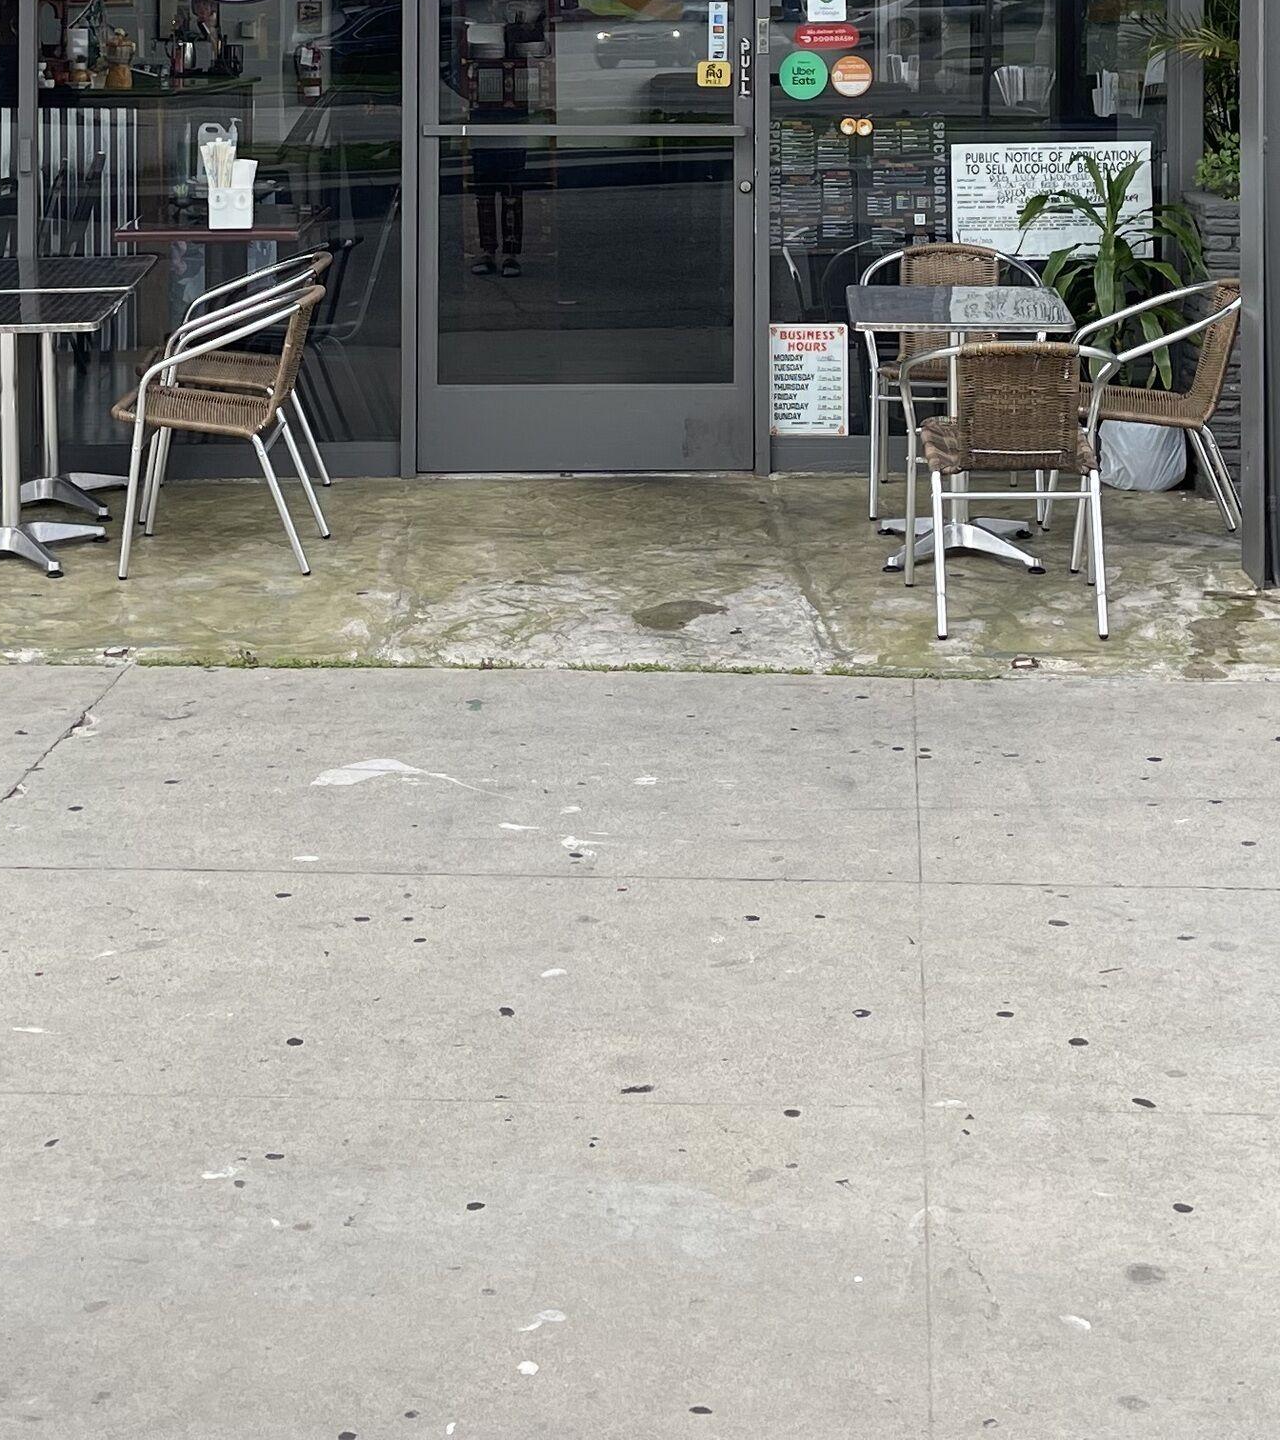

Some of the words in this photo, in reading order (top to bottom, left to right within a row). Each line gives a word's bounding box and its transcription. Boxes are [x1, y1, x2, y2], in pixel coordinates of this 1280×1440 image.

[813, 35, 854, 43] DOORDASH
[792, 66, 816, 76] Uber
[792, 76, 816, 86] Eats
[770, 121, 781, 165] SPICY
[933, 121, 946, 162] SPICY
[965, 151, 1000, 164] PUBLIC
[1005, 151, 1044, 163] NOTICE
[1049, 151, 1063, 163] OF
[966, 164, 980, 175] TO
[986, 163, 1007, 175] SELL
[1012, 162, 1071, 174] ALCOHOLIC
[770, 166, 781, 215] SUGAR
[933, 166, 947, 214] SUGAR
[780, 330, 835, 340] BUSINESS
[787, 342, 828, 352] HOURS
[773, 363, 804, 372] TUESDAY
[773, 373, 815, 382] WEDNESDAY
[773, 383, 809, 391] THURSDAY
[773, 393, 797, 401] FRIDAY
[773, 403, 809, 411] SATURDAY
[773, 412, 801, 421] SUNDAY
